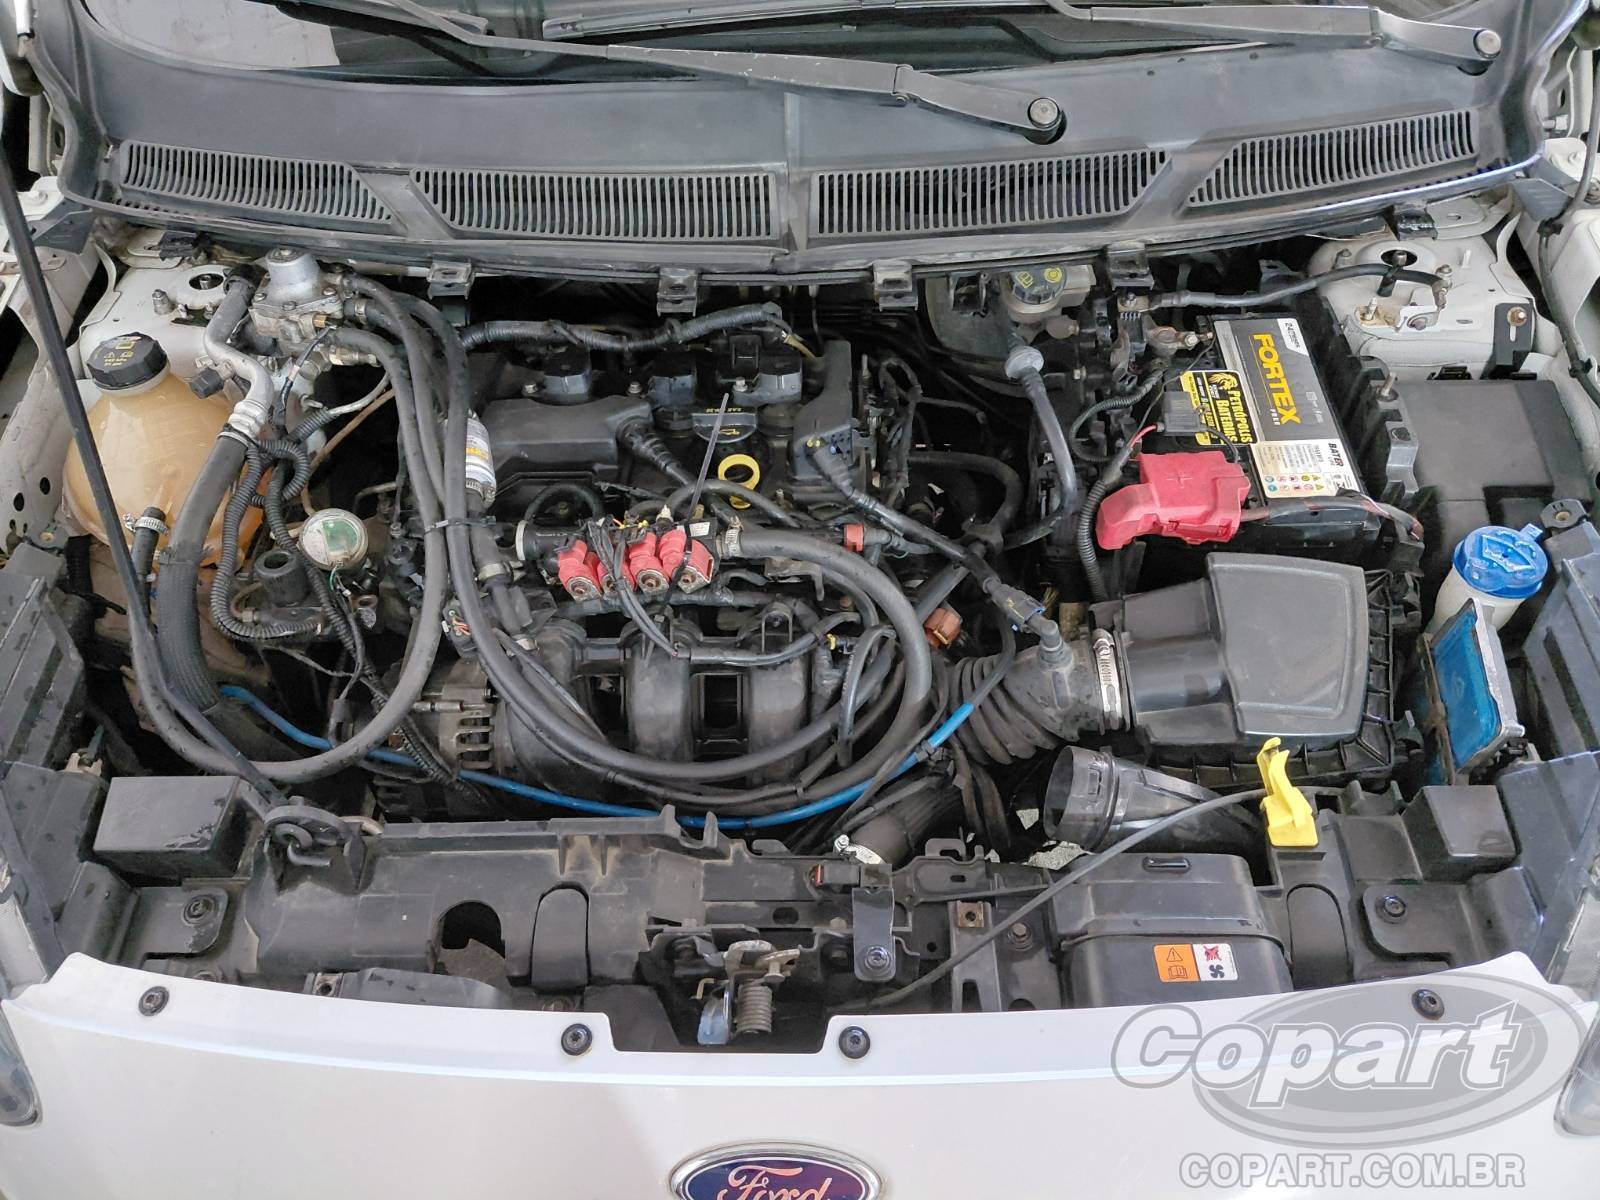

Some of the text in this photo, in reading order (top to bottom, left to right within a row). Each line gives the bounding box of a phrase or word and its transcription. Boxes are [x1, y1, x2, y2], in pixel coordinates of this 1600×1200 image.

[1252, 333, 1301, 425] FORTEX
[1215, 399, 1239, 442] BATERIAS
[1227, 390, 1254, 443] PETRÓPOLIS
[1269, 407, 1281, 426] FREE
